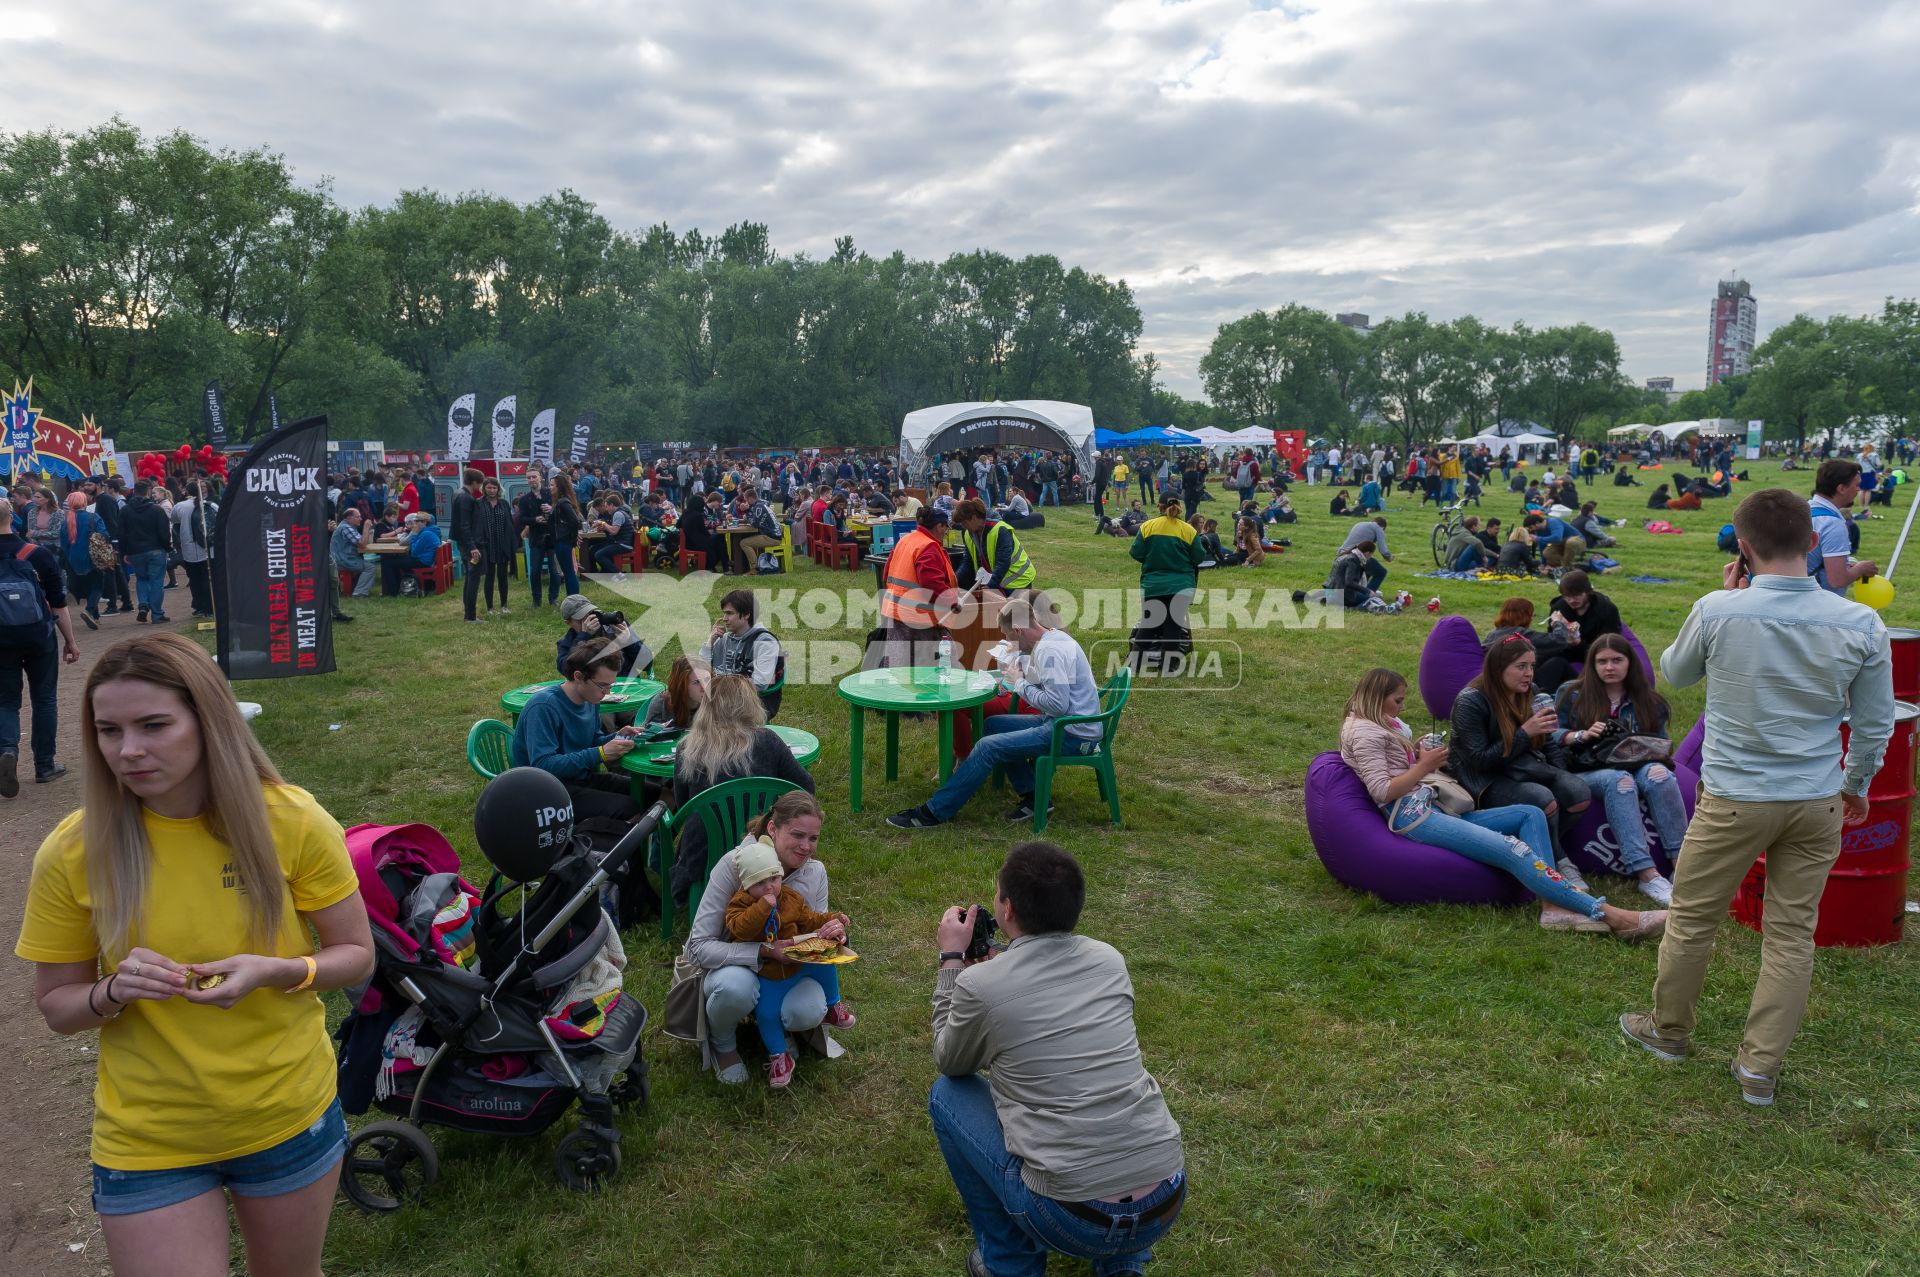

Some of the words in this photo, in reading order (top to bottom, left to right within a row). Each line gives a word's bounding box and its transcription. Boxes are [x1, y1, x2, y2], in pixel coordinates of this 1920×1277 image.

[966, 420, 998, 431] ВКУСАХ
[1000, 420, 1029, 429] СПОРЯТ
[534, 426, 550, 459] ITA'S
[268, 453, 300, 463] MEATAREA
[263, 495, 278, 507] TRUE
[266, 528, 287, 578] CHUCK
[291, 524, 313, 575] TRUST
[294, 577, 315, 603] WE
[268, 581, 291, 664] MEATAREA
[296, 607, 316, 649] MEAT
[297, 652, 317, 669] IN
